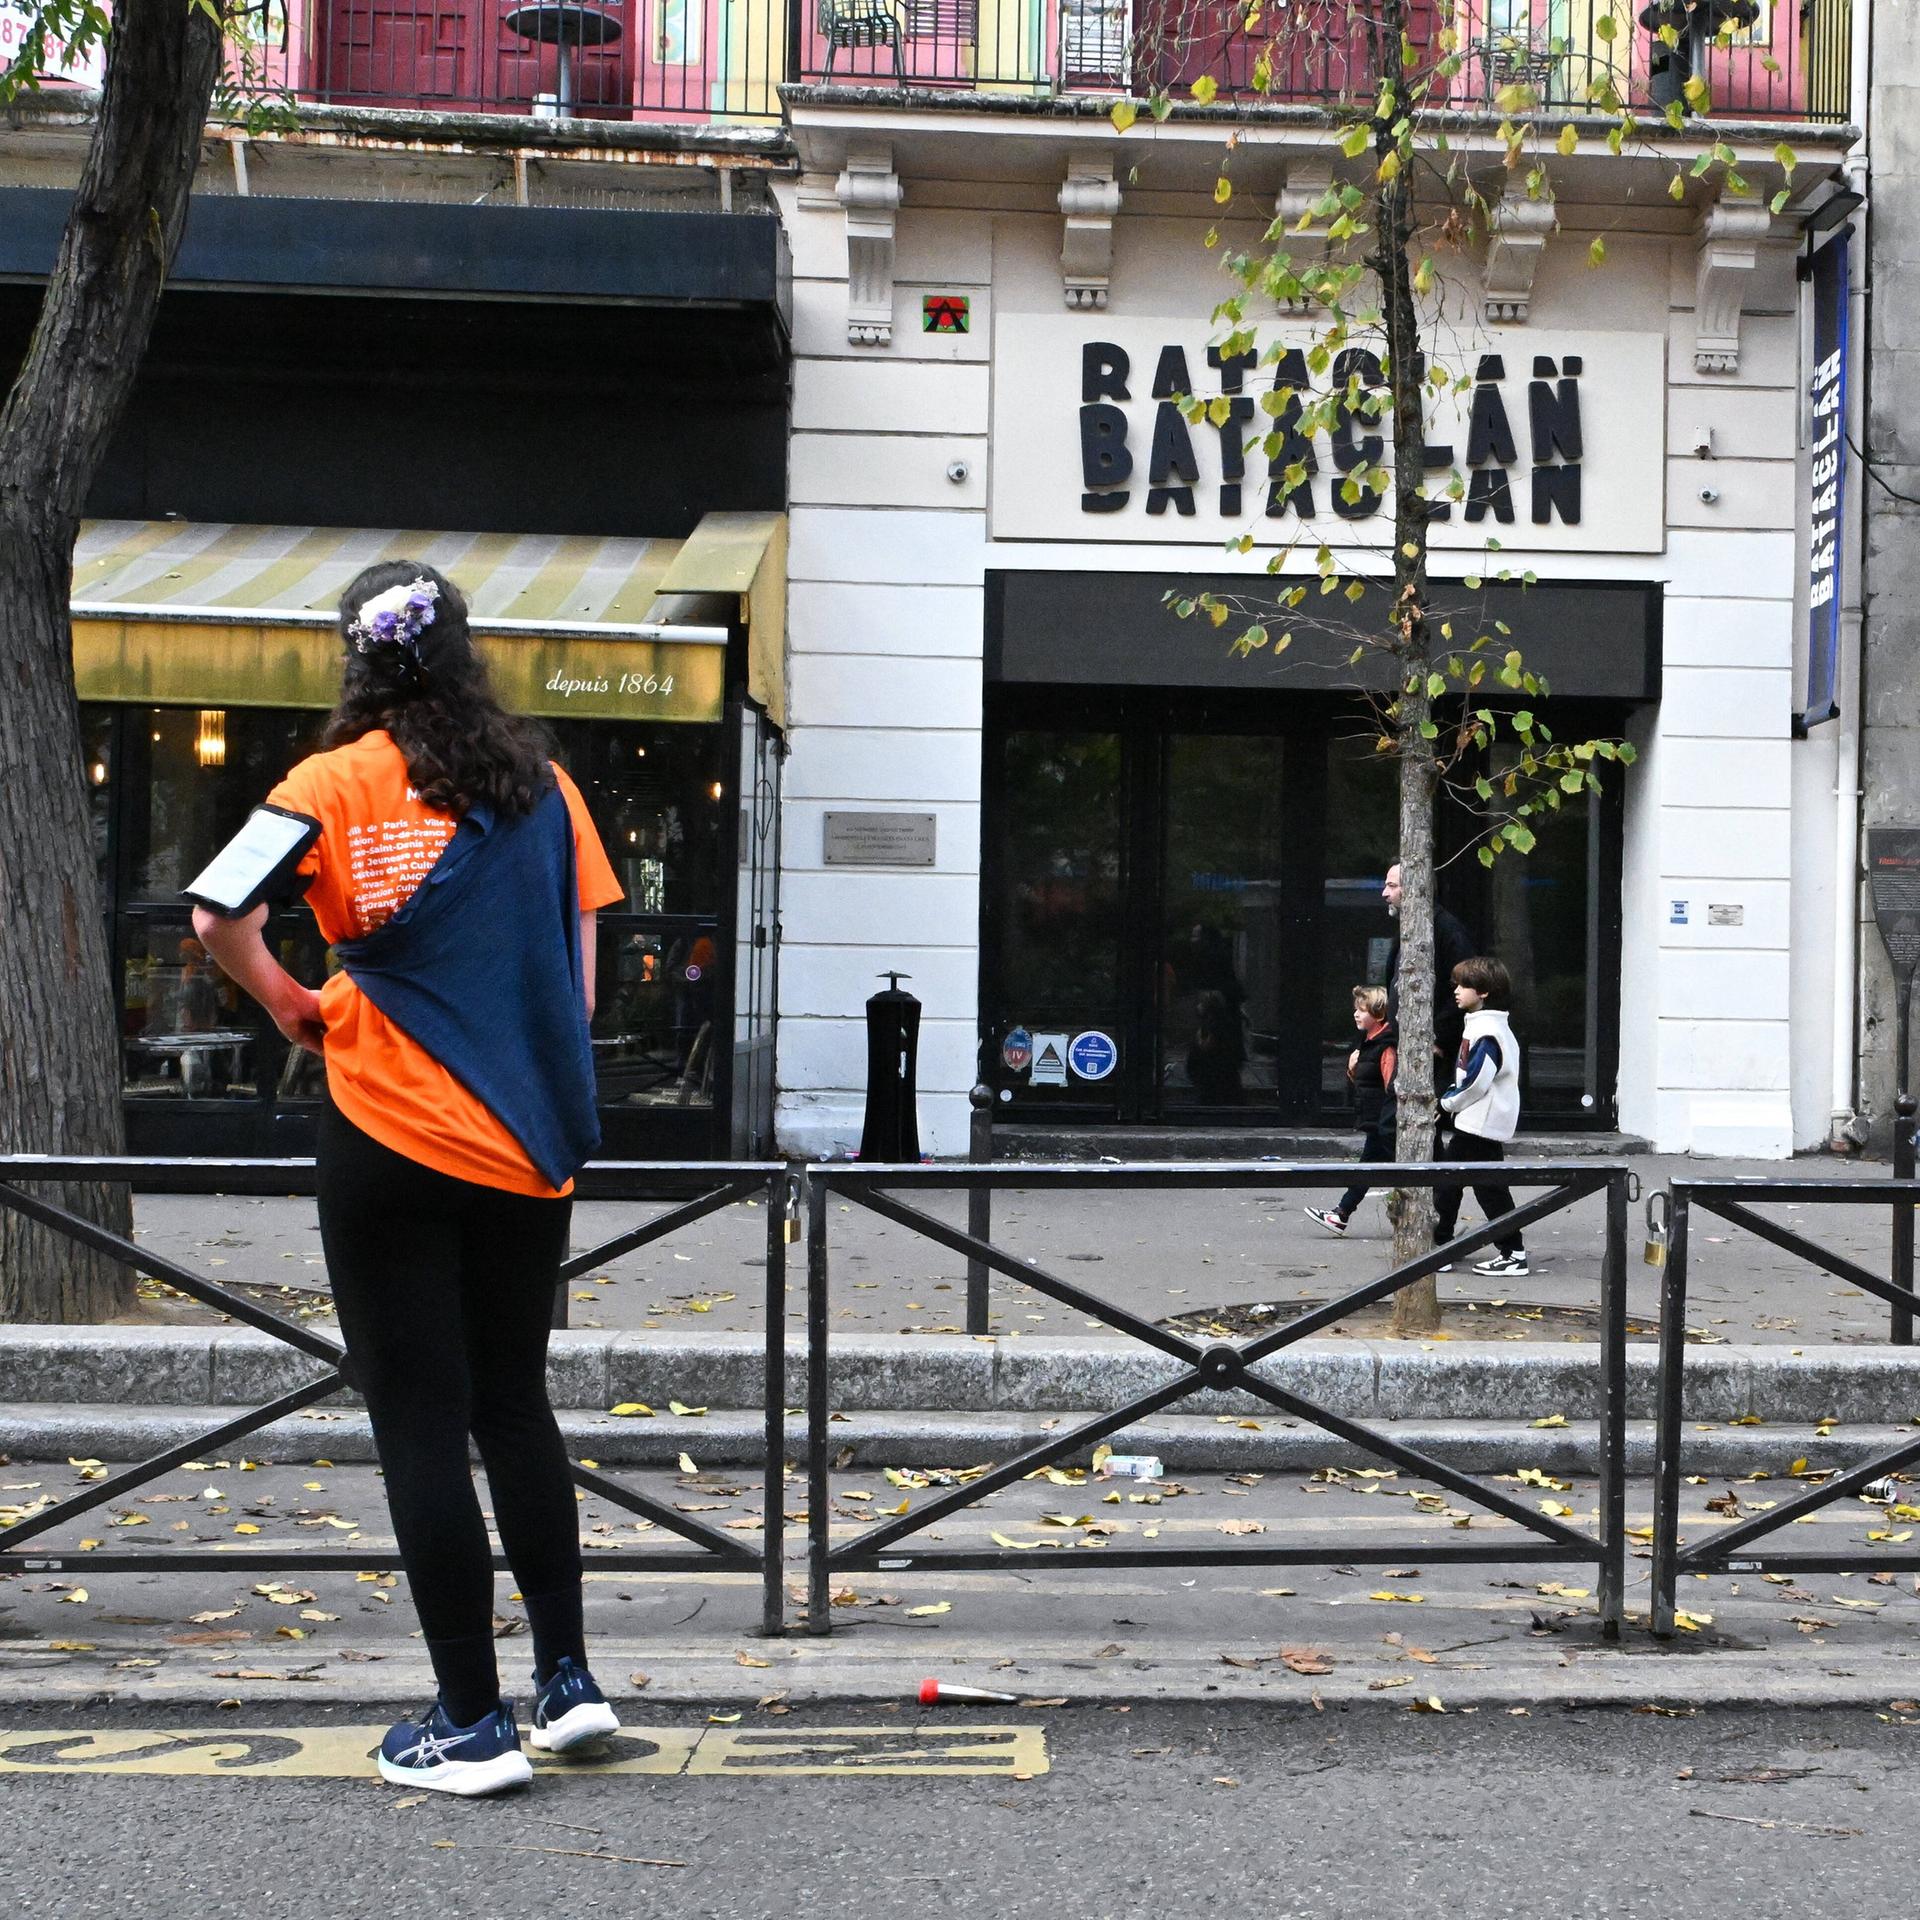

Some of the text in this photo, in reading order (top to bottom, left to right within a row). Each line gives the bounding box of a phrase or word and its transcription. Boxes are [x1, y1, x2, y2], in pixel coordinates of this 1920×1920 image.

[1079, 341, 1583, 525] BATACLAN
[1810, 349, 1841, 609] BATACLAN
[545, 668, 674, 698] depuis 1864
[383, 819, 409, 830] Paris
[424, 818, 446, 827] Ville
[367, 851, 411, 867] Jeunesse
[413, 850, 425, 859] et
[386, 865, 399, 875] de
[399, 861, 409, 871] la
[1012, 1051, 1023, 1060] IV
